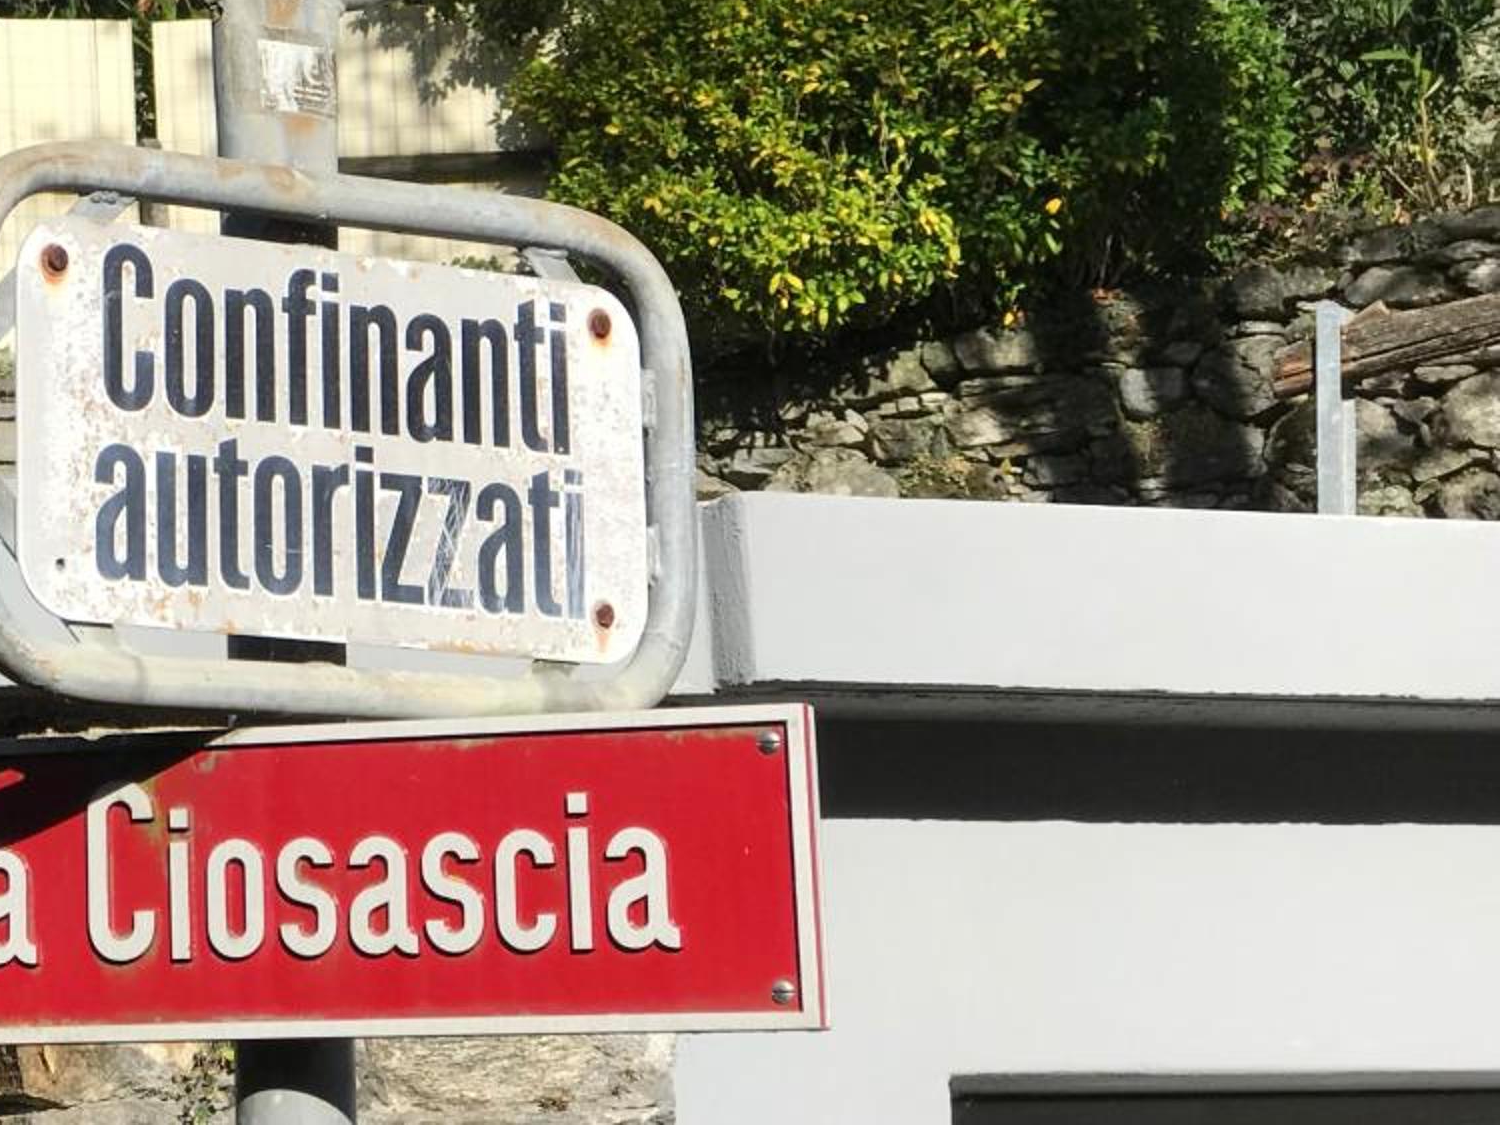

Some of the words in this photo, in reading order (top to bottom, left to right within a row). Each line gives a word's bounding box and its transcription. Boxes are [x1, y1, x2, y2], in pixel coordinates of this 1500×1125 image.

[103, 244, 570, 455] Confinanti
[95, 439, 586, 620] autorizzati
[87, 781, 682, 965] Ciosascia
